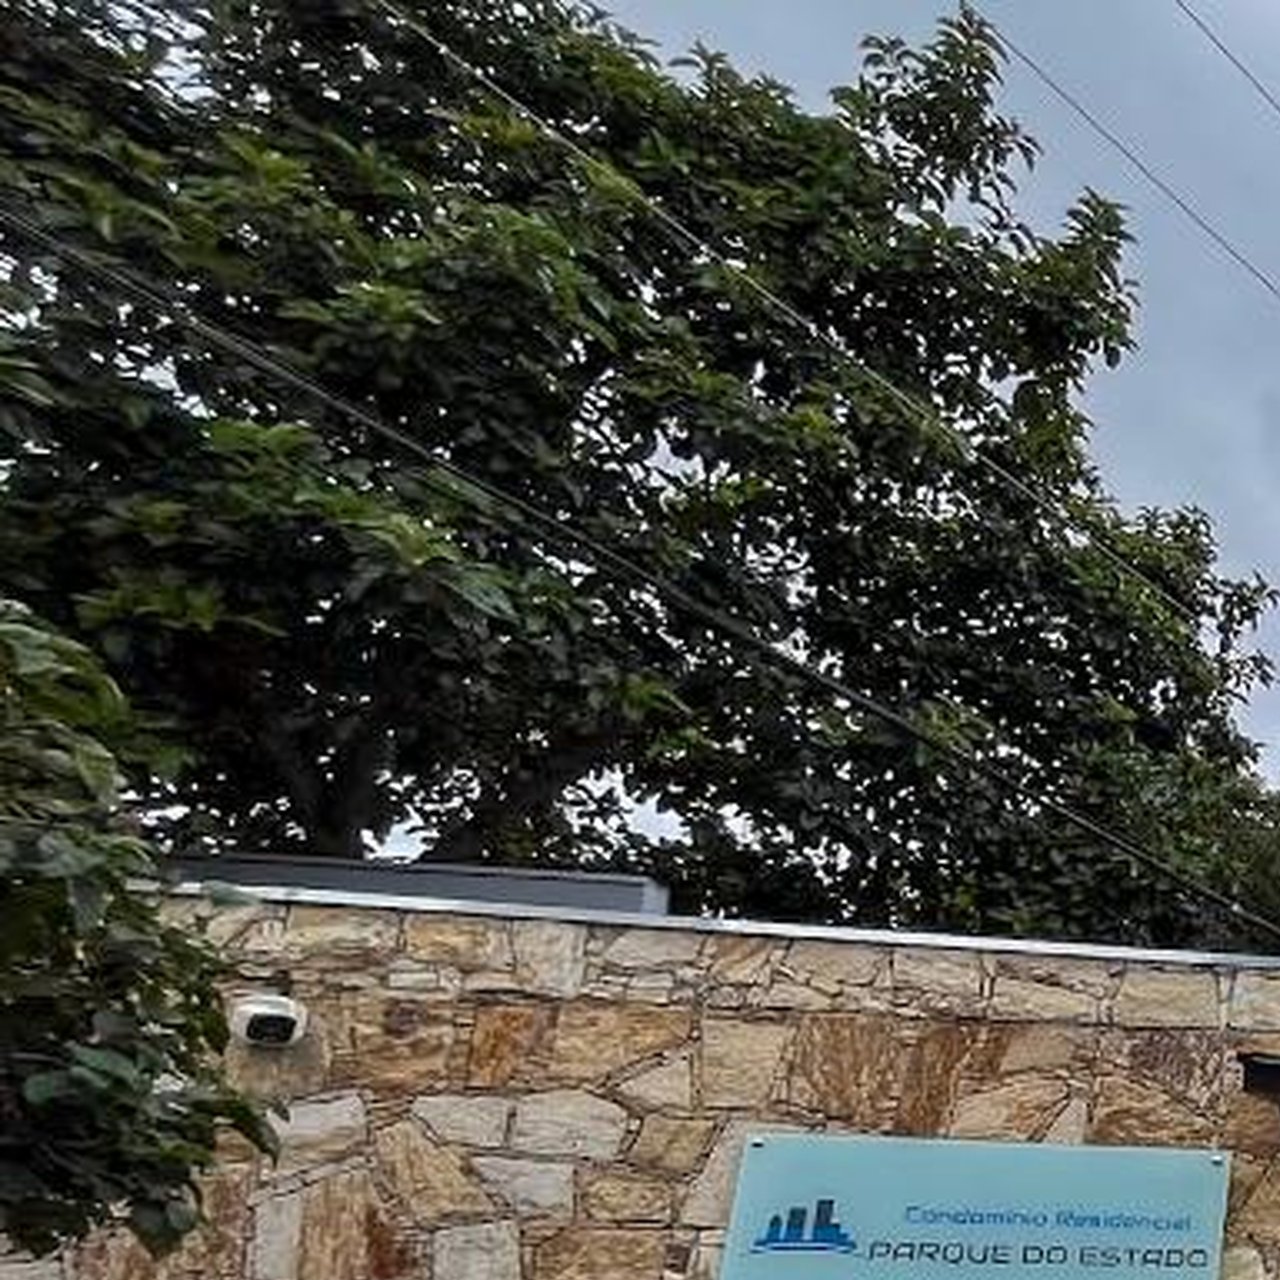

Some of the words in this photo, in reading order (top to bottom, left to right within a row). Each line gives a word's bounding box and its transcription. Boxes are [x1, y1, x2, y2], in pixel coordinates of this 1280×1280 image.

[1055, 1209, 1192, 1231] Residencial
[867, 1241, 1012, 1266] PARQUE
[1021, 1244, 1069, 1265] DO
[1079, 1245, 1209, 1269] ESTADO
